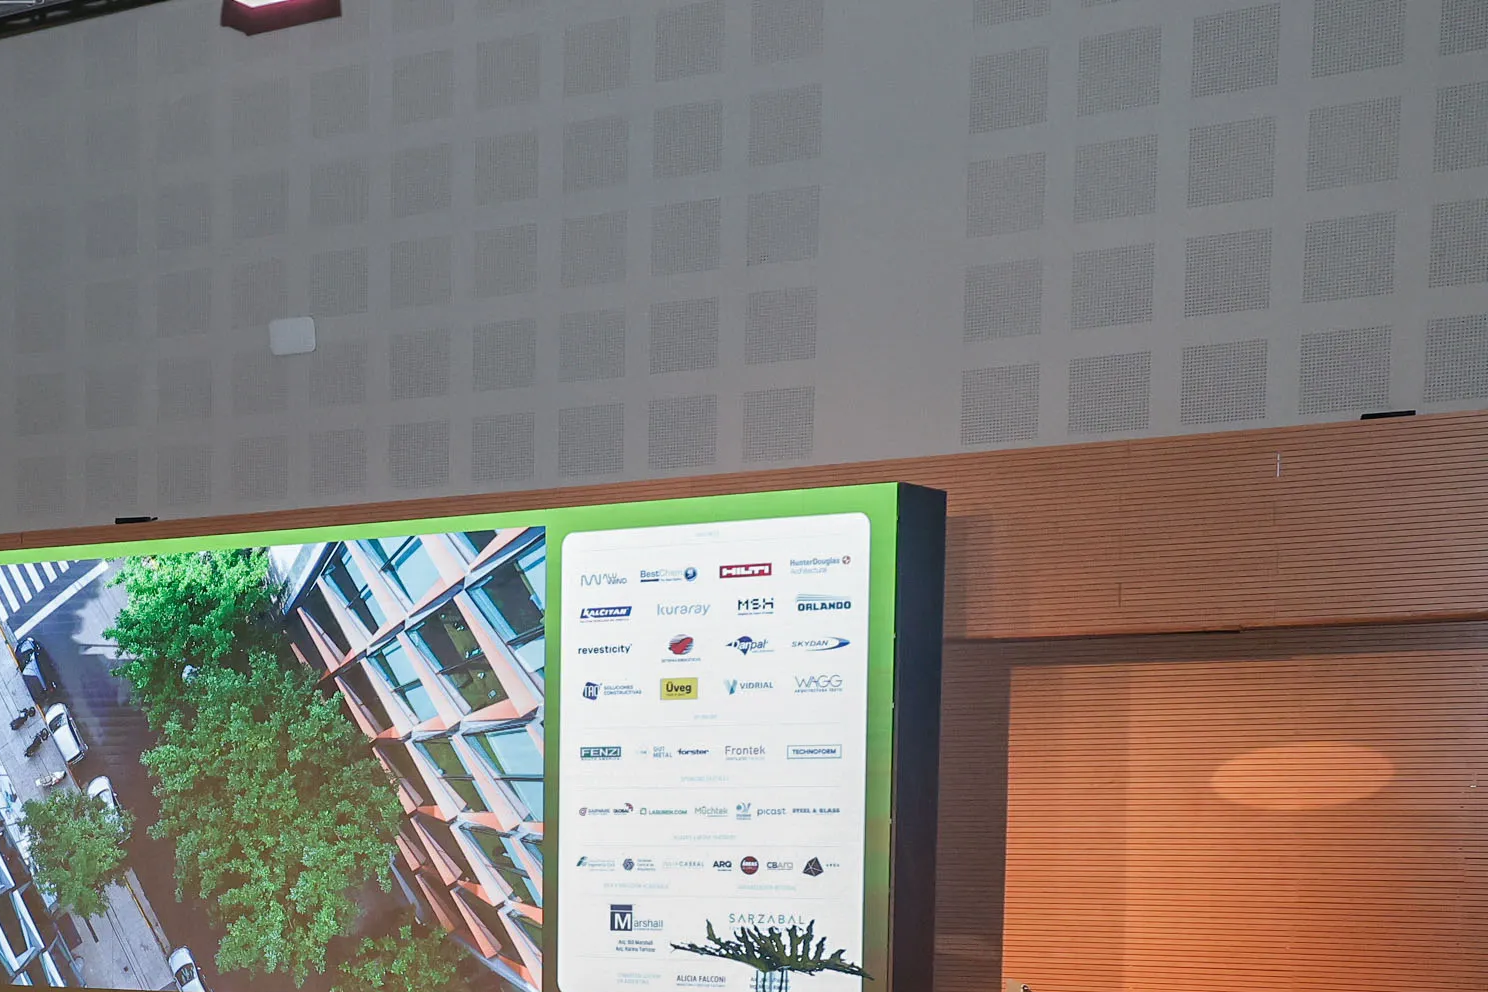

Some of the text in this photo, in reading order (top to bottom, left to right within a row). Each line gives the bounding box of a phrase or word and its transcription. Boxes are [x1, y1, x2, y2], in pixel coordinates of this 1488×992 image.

[790, 556, 840, 567] HunterDouglas
[721, 565, 770, 577] HILTI
[657, 603, 711, 616] kuraray
[738, 597, 774, 611] MSH
[797, 601, 852, 612] ORLANDO
[578, 644, 631, 655] revesticity
[792, 640, 829, 648] SKYDAN
[740, 681, 774, 689] VIDRIAL
[794, 674, 843, 688] WAGG
[666, 681, 692, 694] Üveg
[581, 747, 621, 757] FENZI
[725, 744, 766, 756] Frontek
[757, 807, 787, 816] picast
[713, 860, 732, 868] ARQ
[614, 913, 663, 930] Marshall
[729, 913, 805, 924] SARZABAL
[699, 975, 726, 983] FALCONI
